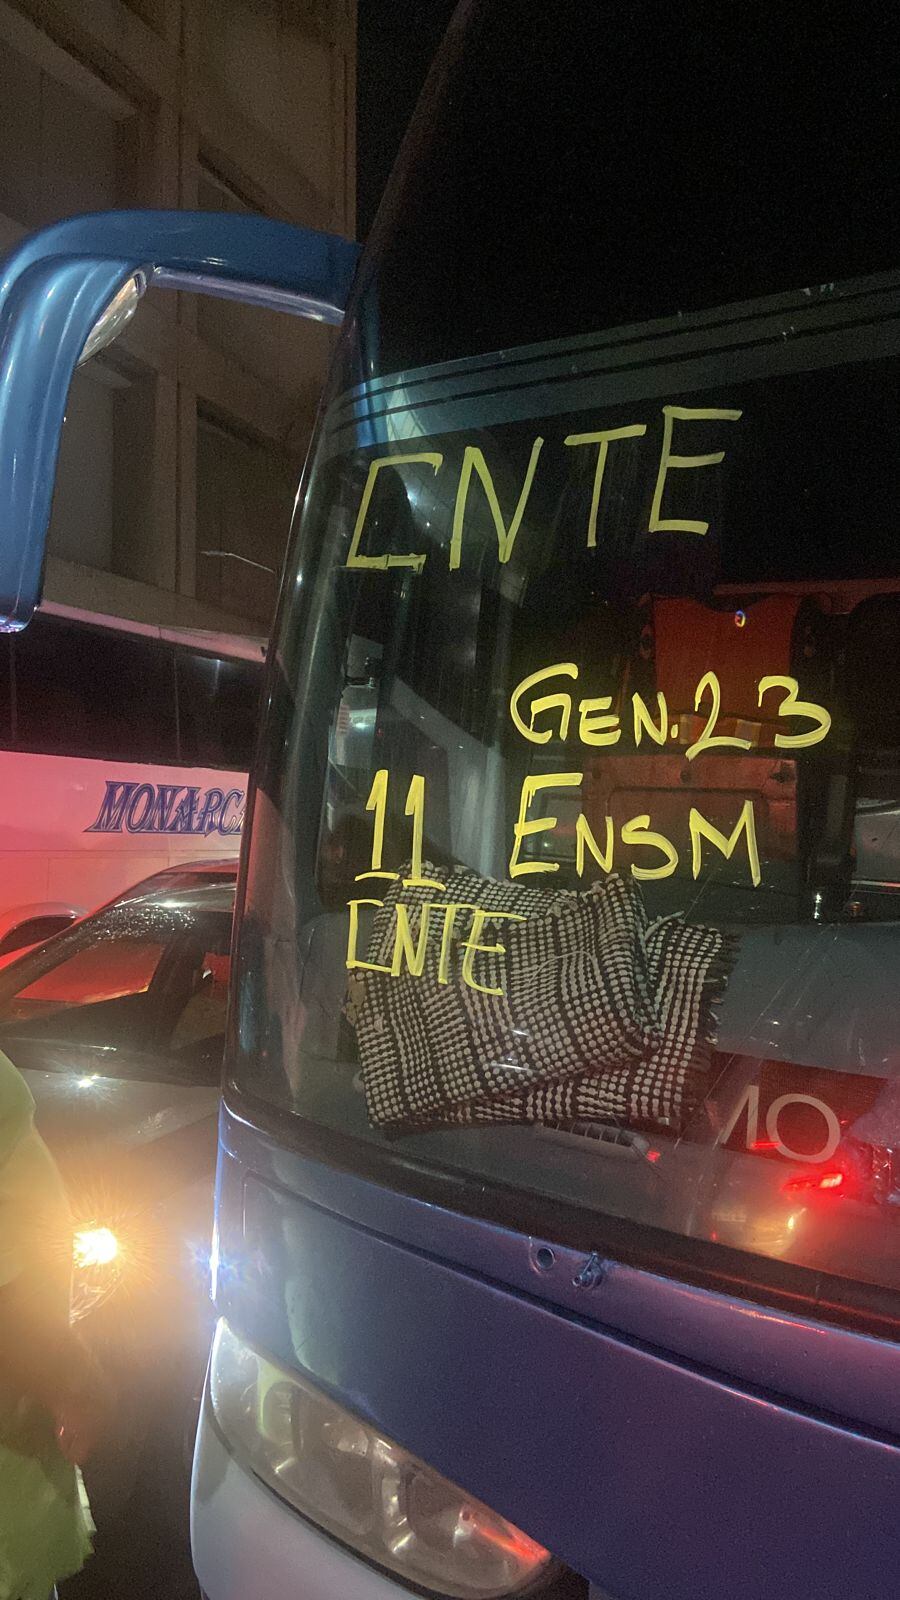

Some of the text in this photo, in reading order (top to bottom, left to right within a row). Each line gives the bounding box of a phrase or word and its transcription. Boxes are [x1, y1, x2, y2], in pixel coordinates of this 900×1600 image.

[346, 405, 743, 570] CNTE
[83, 780, 247, 838] MONARC
[509, 772, 762, 888] ENSM
[346, 899, 528, 997] CNTE
